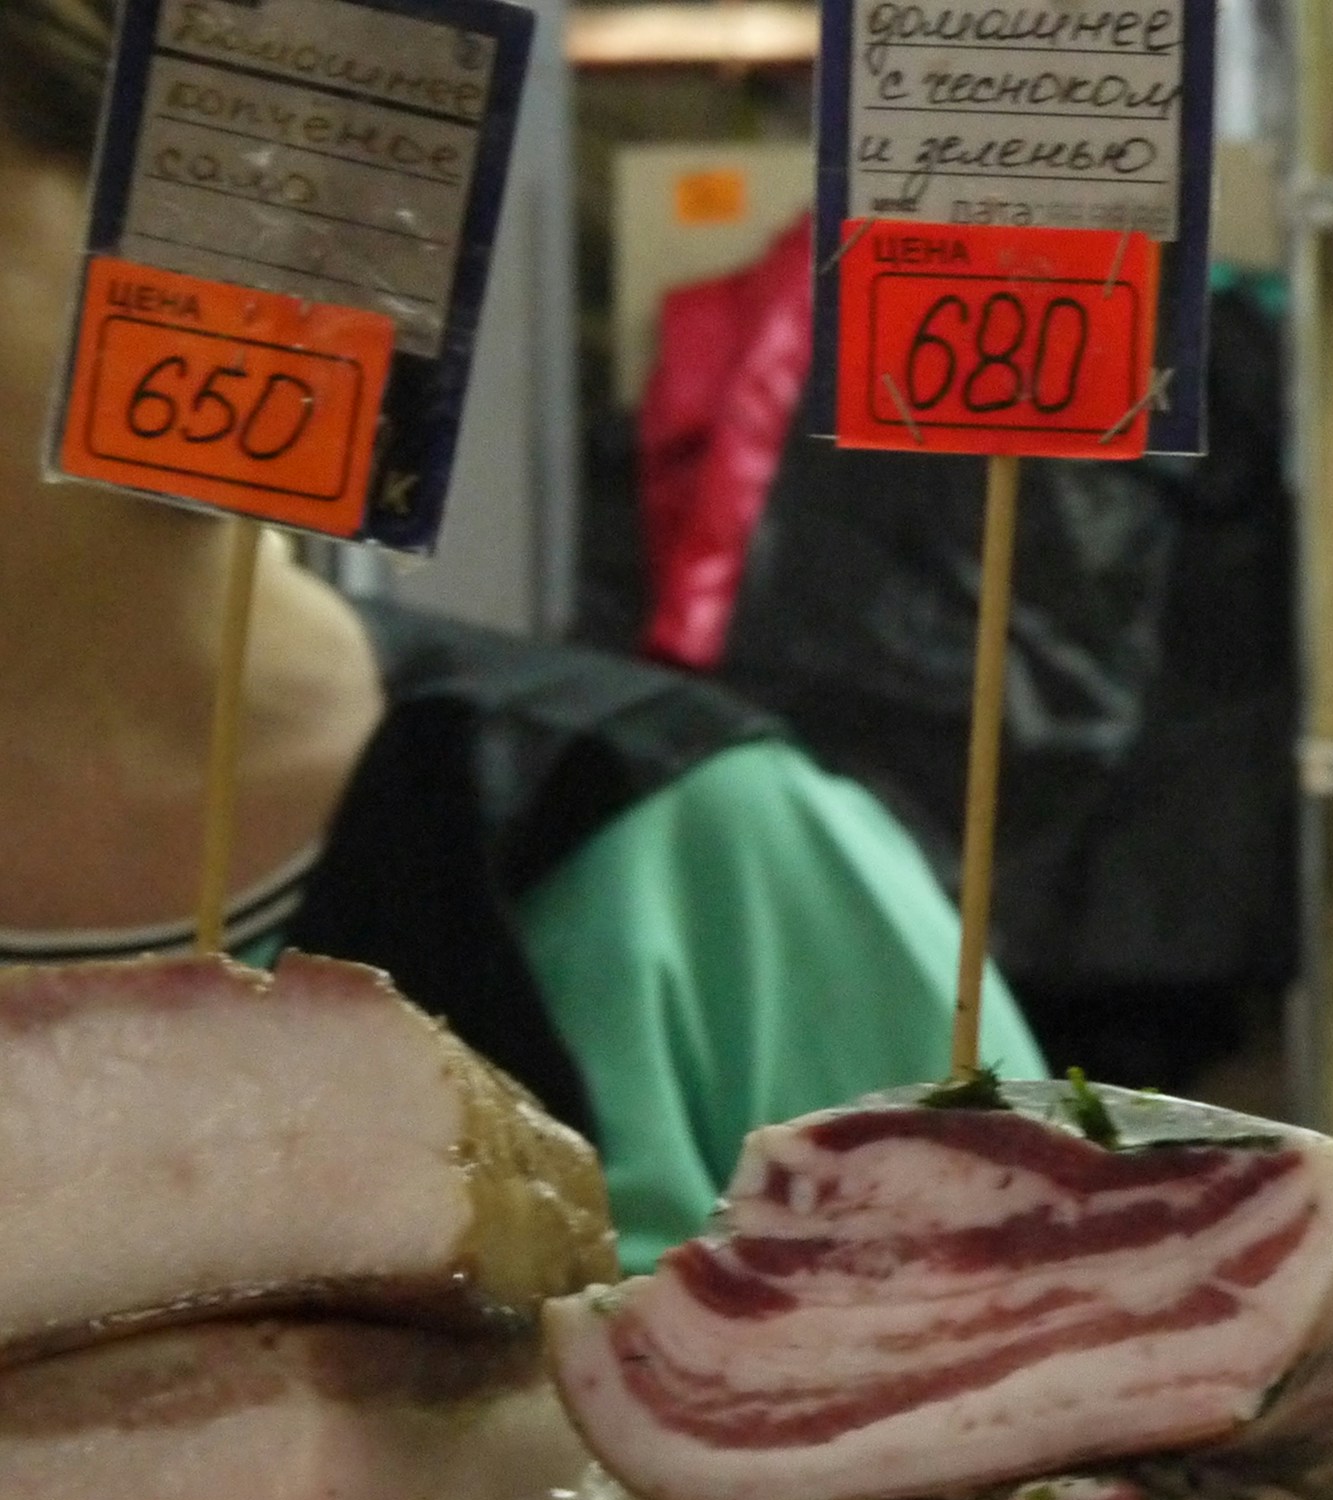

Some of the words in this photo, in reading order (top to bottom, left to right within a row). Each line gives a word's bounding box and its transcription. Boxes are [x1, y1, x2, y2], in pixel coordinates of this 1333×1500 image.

[864, 2, 1184, 76] домашнее
[880, 70, 908, 101] с
[858, 134, 893, 163] и
[903, 134, 1157, 202] зеленью
[872, 236, 970, 265] ЦЕНА
[108, 279, 200, 321] ЦЕНА
[907, 291, 1090, 415] 680
[127, 354, 317, 462] 650
